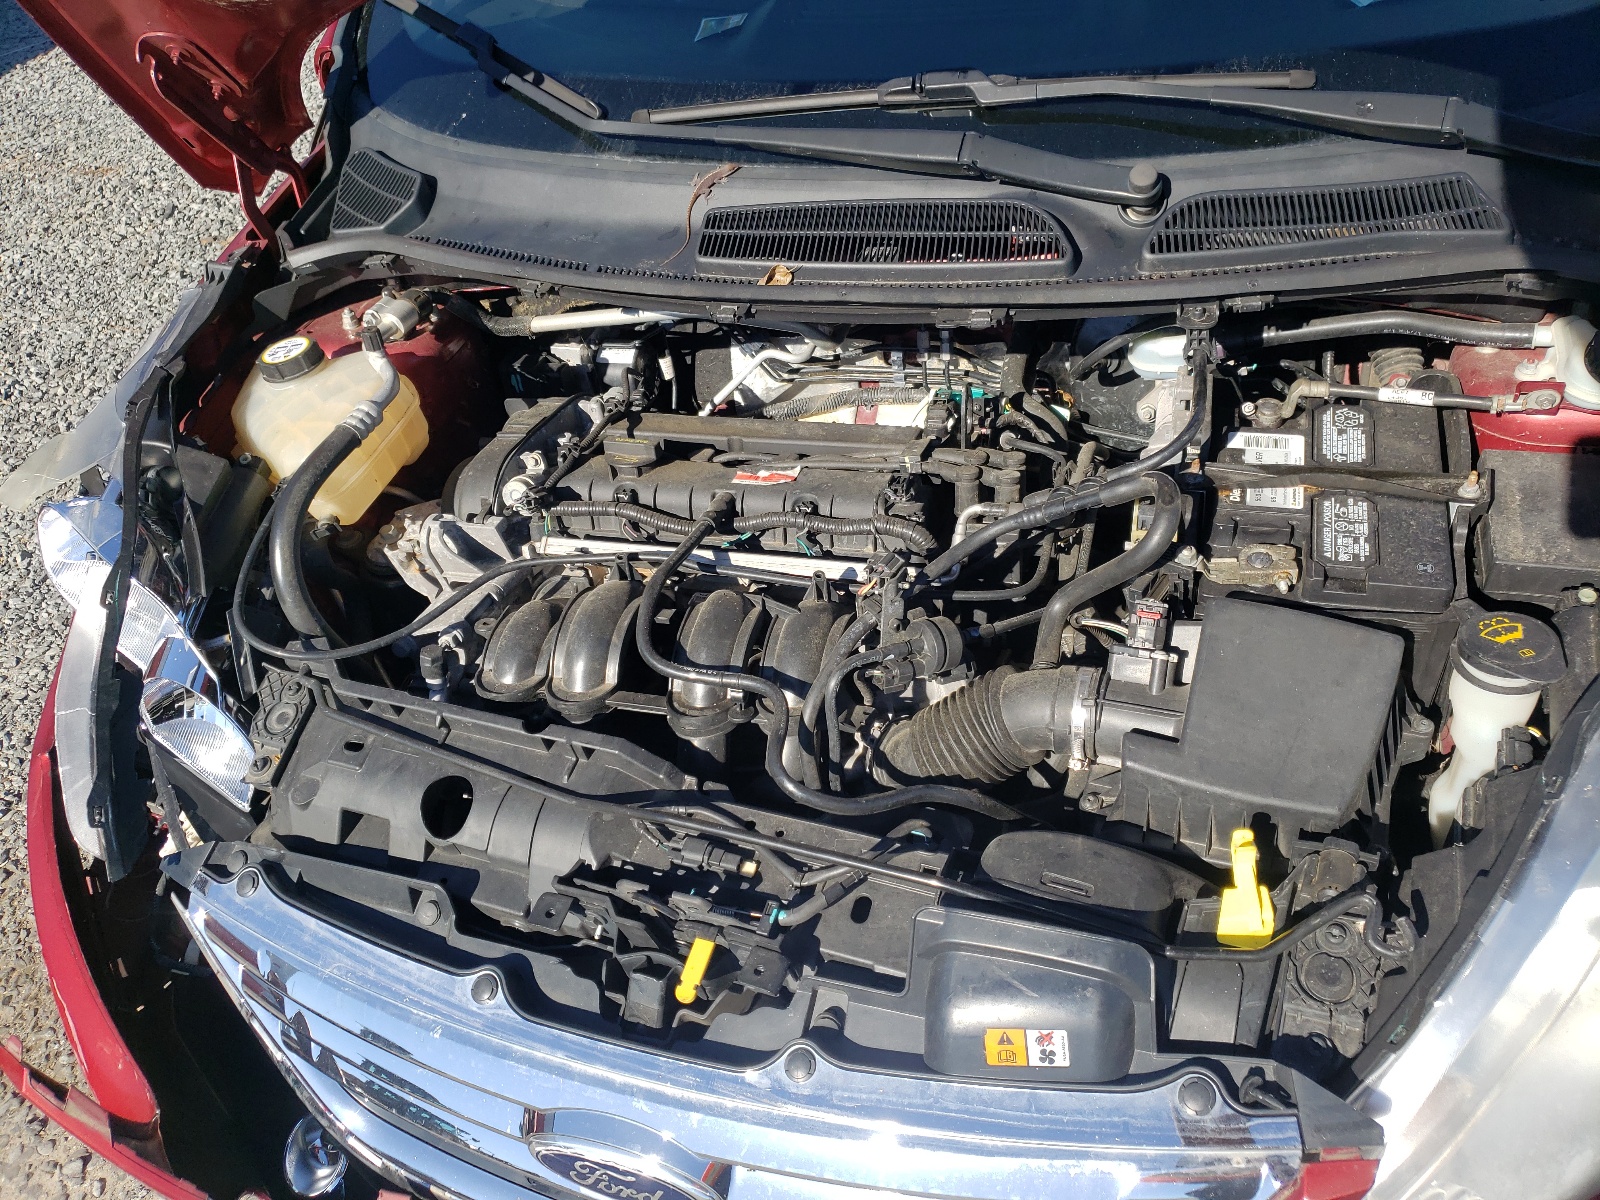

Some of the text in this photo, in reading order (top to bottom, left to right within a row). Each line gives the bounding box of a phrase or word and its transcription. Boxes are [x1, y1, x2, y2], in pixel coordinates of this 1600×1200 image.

[1323, 501, 1332, 522] POISON
[1323, 528, 1332, 552] DANGER
[569, 1161, 664, 1200] Ford
